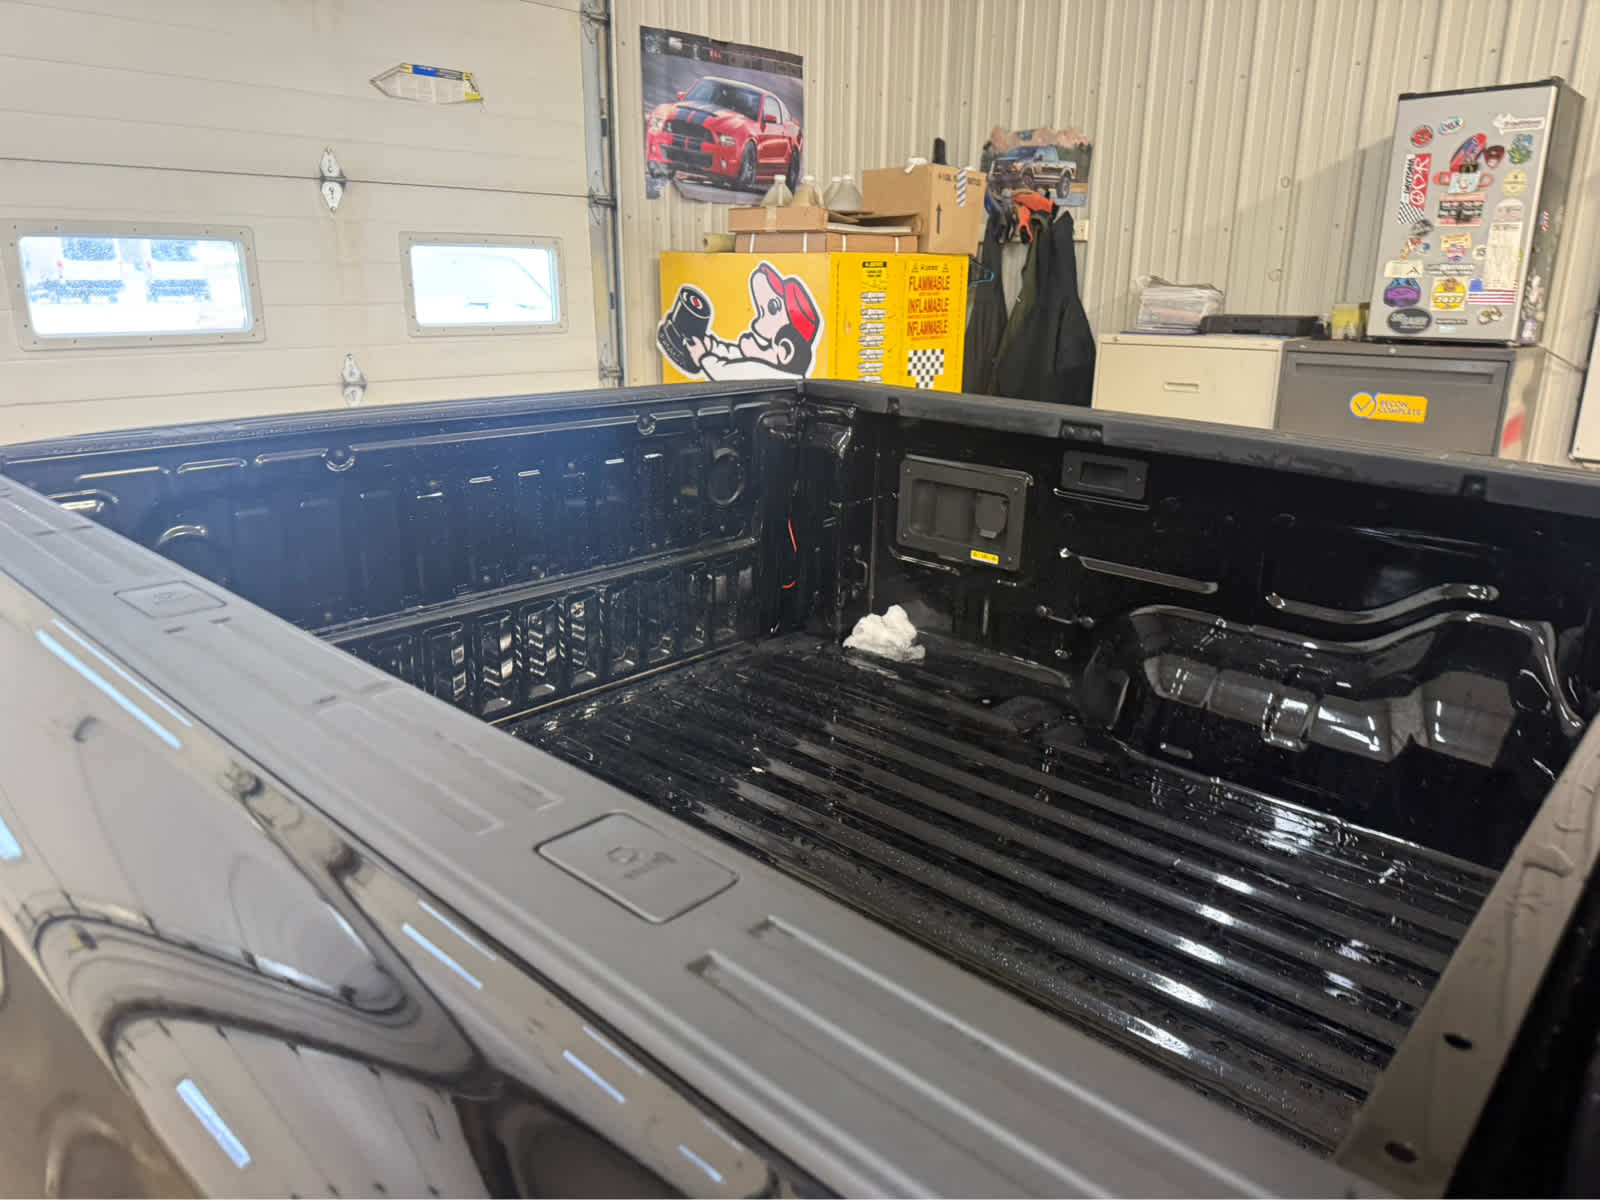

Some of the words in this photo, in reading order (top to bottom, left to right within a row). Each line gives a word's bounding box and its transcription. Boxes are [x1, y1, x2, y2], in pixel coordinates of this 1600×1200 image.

[908, 275, 951, 292] FLAMMABLE
[1380, 399, 1409, 408] RECON
[1377, 407, 1422, 416] COMPLETE
